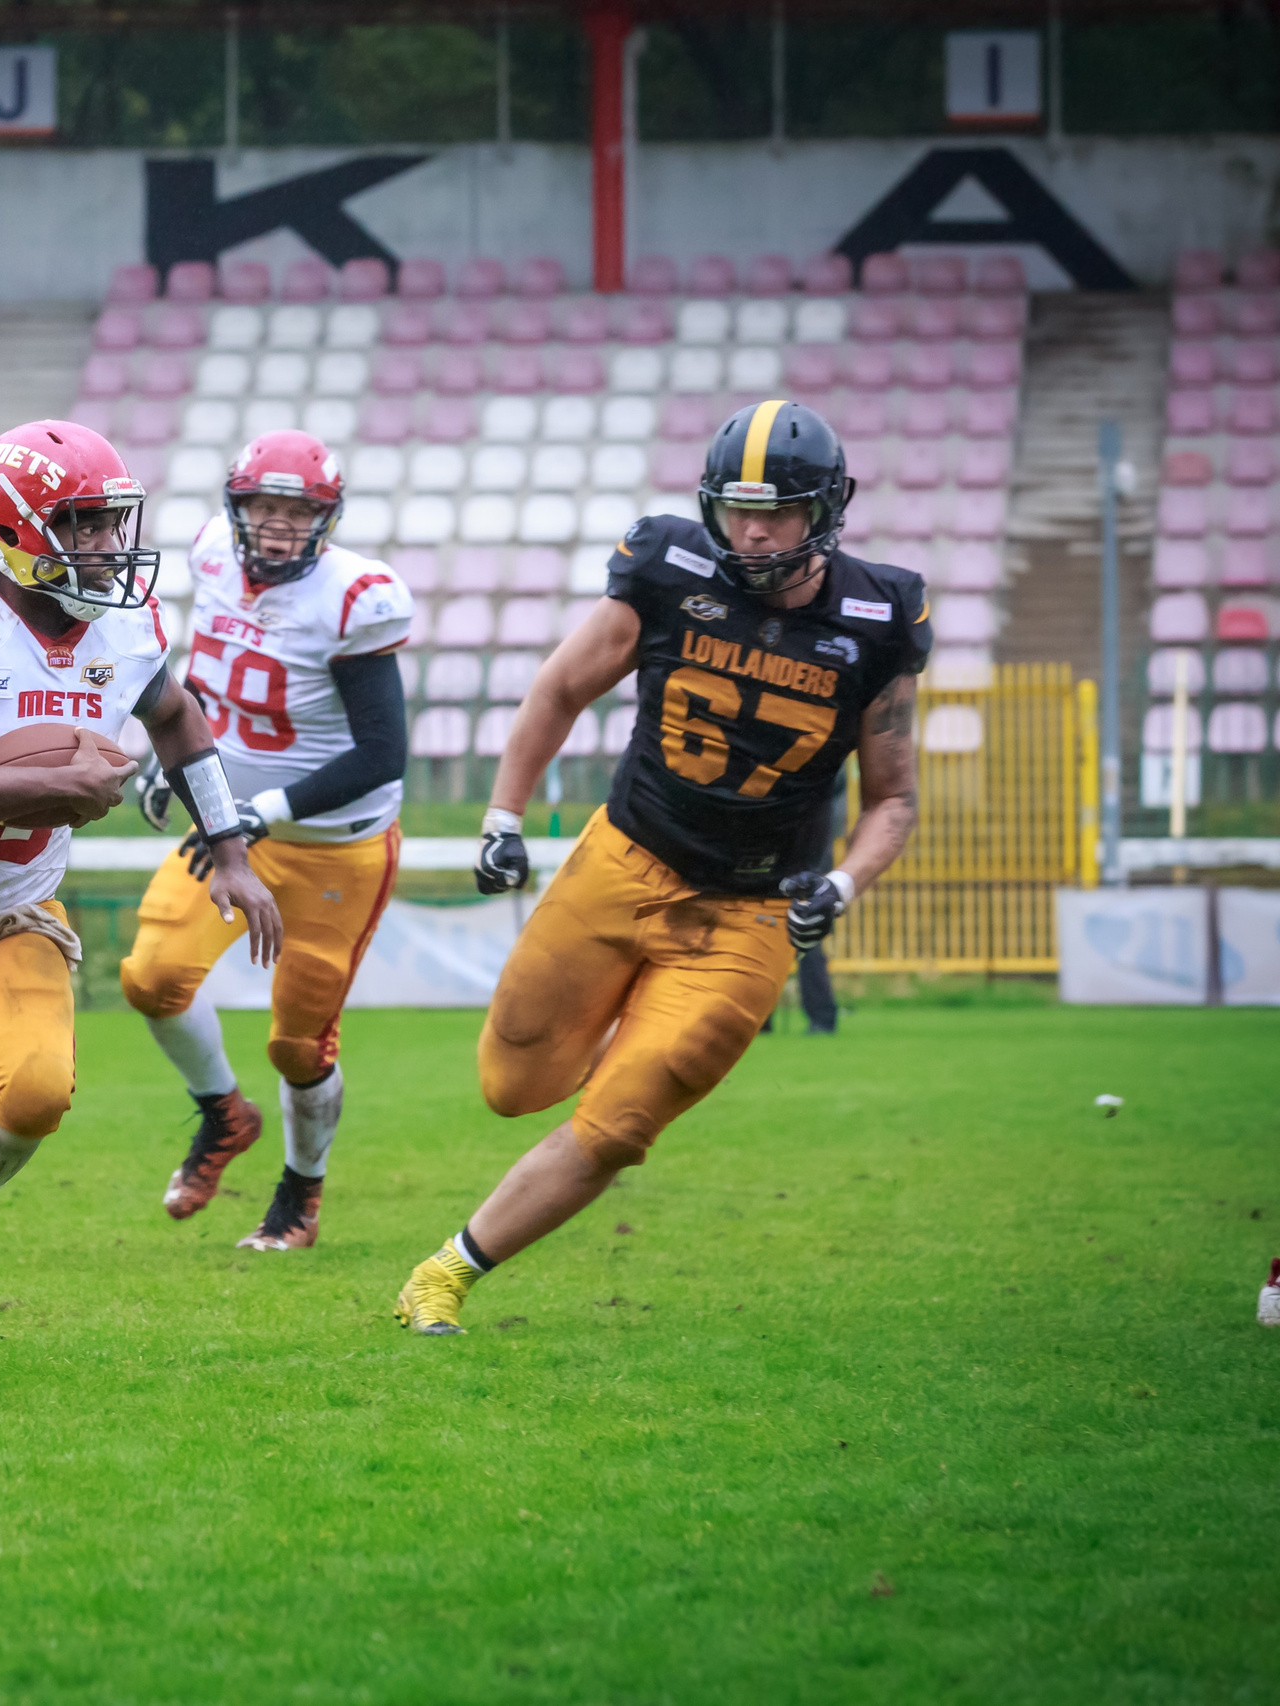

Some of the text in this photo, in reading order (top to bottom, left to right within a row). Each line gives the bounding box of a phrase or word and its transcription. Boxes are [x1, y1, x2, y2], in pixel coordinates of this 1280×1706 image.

[986, 42, 1001, 110] I
[210, 614, 268, 648] METS
[49, 656, 73, 666] METS
[85, 668, 113, 678] LFA
[681, 630, 839, 698] LOWLANDERS
[17, 689, 103, 719] METS
[660, 666, 838, 798] 67
